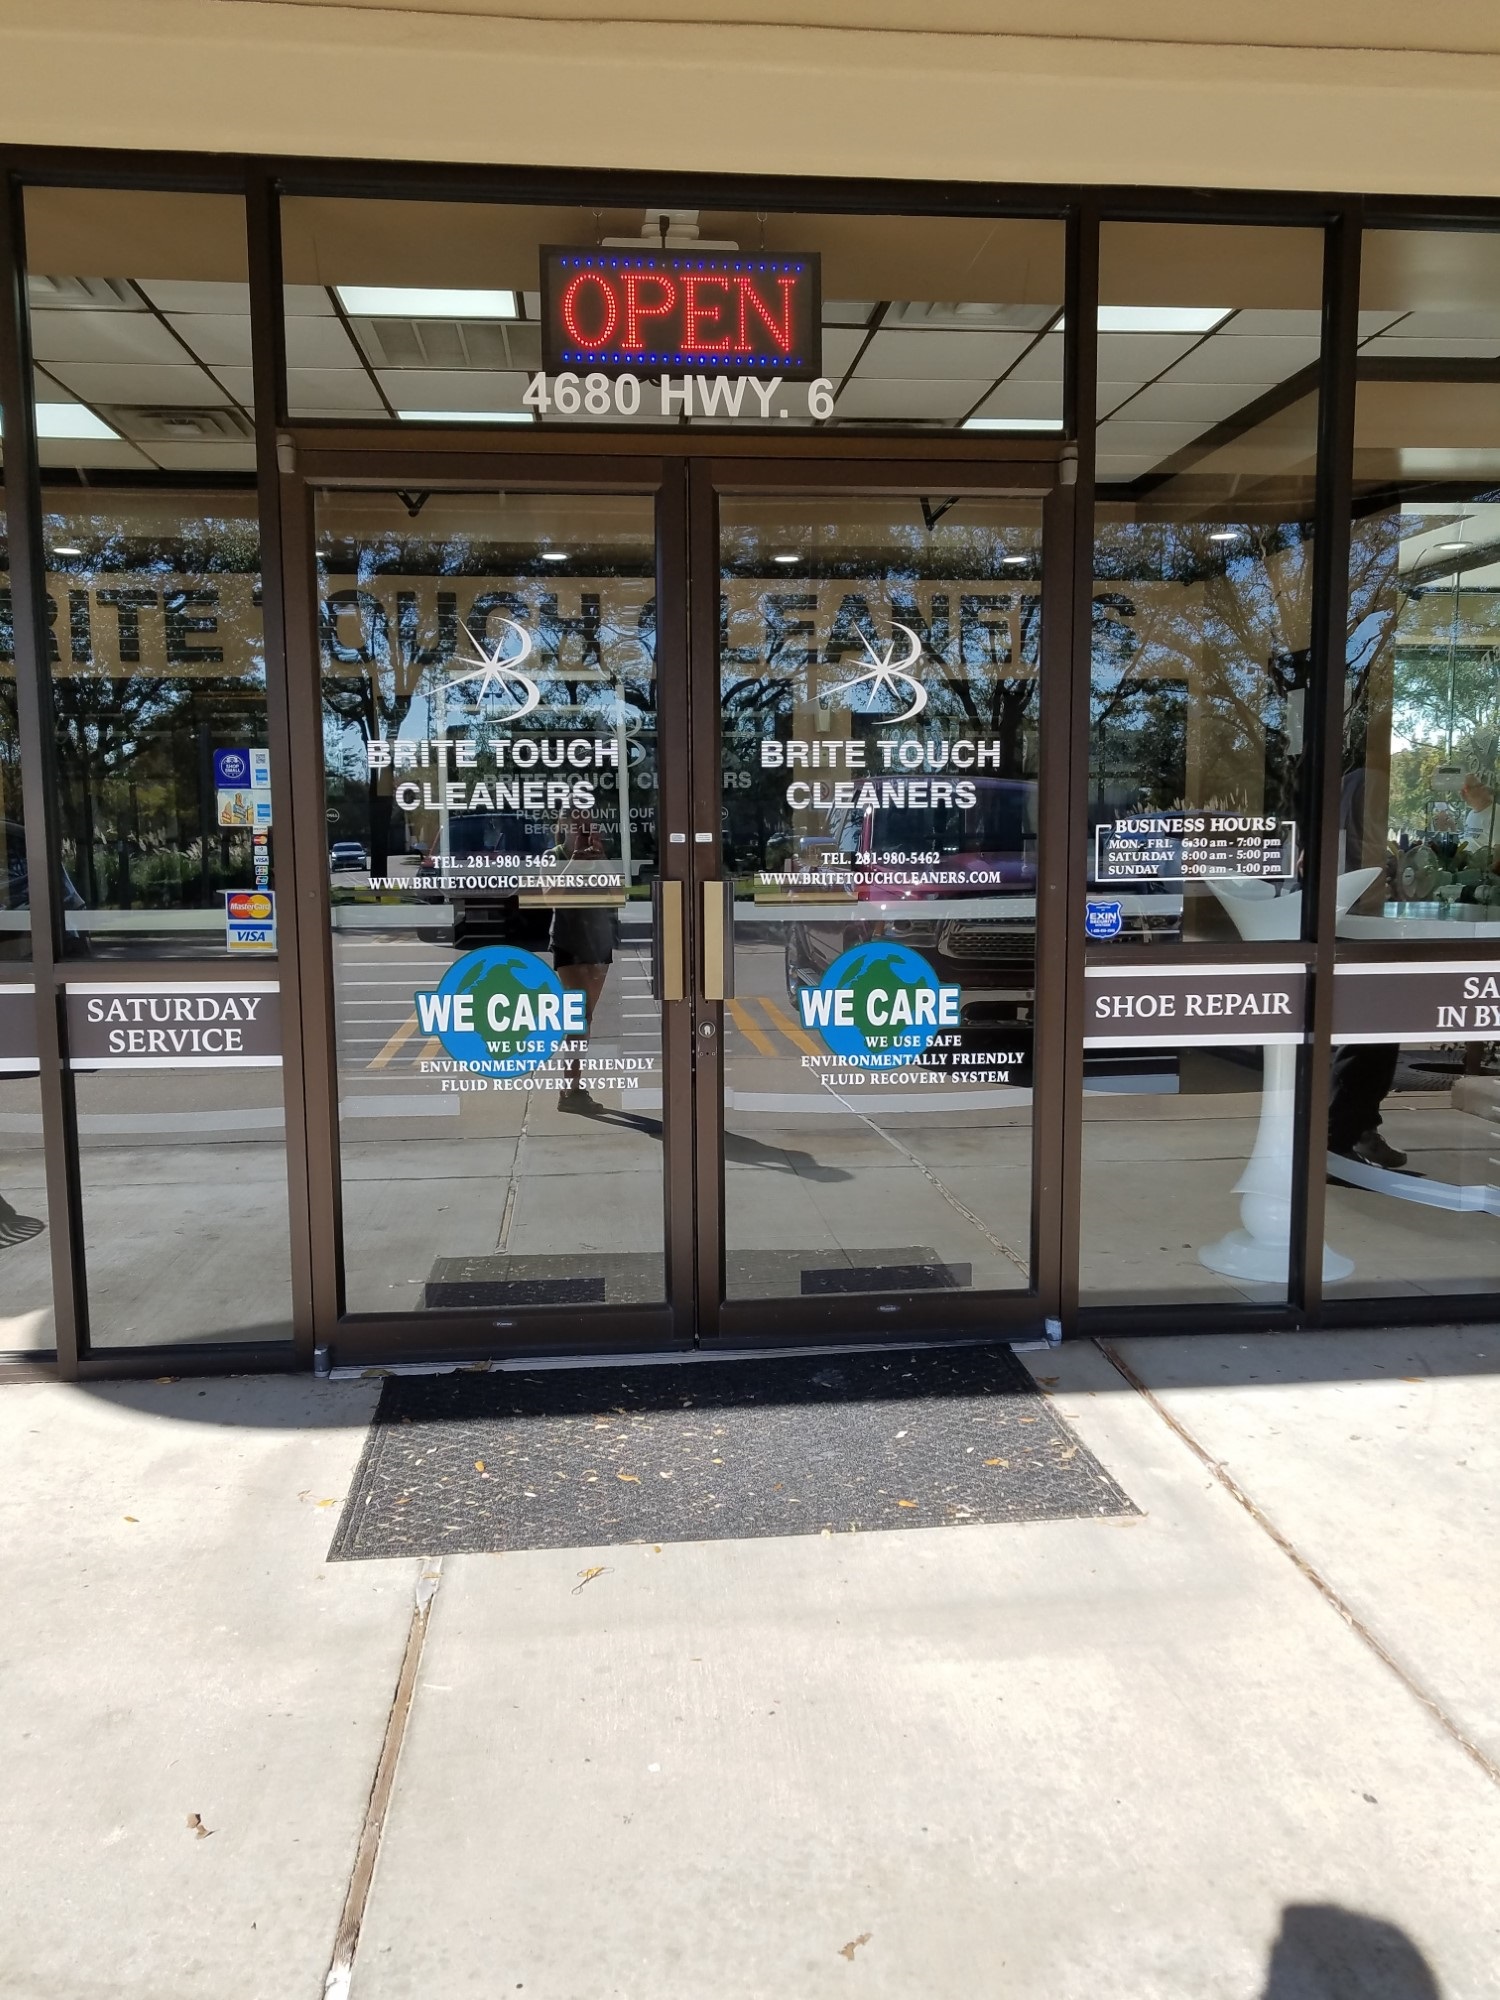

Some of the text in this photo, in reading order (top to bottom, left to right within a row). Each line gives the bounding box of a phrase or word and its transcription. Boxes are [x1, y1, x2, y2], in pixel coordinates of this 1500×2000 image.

[562, 273, 796, 352] OPEN
[522, 371, 835, 419] 4680 HWY. 6
[367, 738, 619, 768] BRITE TOUCH
[760, 740, 1000, 768] BRITE TOUCH
[395, 781, 596, 810] CLEANERS
[786, 781, 977, 809] CLEANERS
[516, 807, 655, 820] PLEASE COUNT OUR
[524, 823, 578, 835] BEFORE
[582, 822, 637, 834] LEAVIG
[1115, 816, 1277, 833] BUSINESS HOURS
[1147, 838, 1173, 848] FRI.
[1209, 840, 1227, 848] am
[1237, 836, 1261, 847] 7:00
[1262, 838, 1281, 849] pm
[431, 855, 463, 869] TEL.
[821, 851, 941, 866] TEL. 281-980-5462
[1108, 851, 1175, 861] SATURDAY
[1181, 850, 1208, 860] 8:00
[1209, 852, 1227, 860] am
[1236, 850, 1261, 860] 5:00
[1262, 851, 1281, 861] pm
[1108, 864, 1160, 875] SUNDAY
[1181, 864, 1207, 874] 9:00
[1208, 866, 1226, 874] am
[1236, 863, 1261, 873] 1:00
[1262, 865, 1282, 875] pm
[367, 873, 622, 890] WWW.BRITETOUCHCLEANERS.COM
[759, 870, 1002, 886] WWW.BRITETOUCHCLEANERS.COM
[230, 902, 270, 911] MasterCard
[1090, 912, 1117, 920] EXIN
[237, 931, 266, 942] VISA
[1463, 976, 1500, 1000] SA
[87, 997, 262, 1022] SATURDAY
[418, 993, 585, 1033] WE CARE
[801, 988, 959, 1027] WE CARE
[1095, 992, 1293, 1018] SHOE REPAIR
[1436, 1005, 1500, 1028] IN BY
[108, 1028, 244, 1053] SERVICE
[486, 1039, 588, 1053] WE USE SAFE
[865, 1035, 962, 1048] WE USE SAFE
[420, 1057, 655, 1073] ENVIRONMENTALLY FRIENDLY
[801, 1052, 1025, 1067] ENVIRONMENTALLY FRIENDLY
[441, 1077, 639, 1092] FLUID RECOVERY SYSTEM
[821, 1070, 1010, 1086] FLUID RECOVERY SYSTEM
